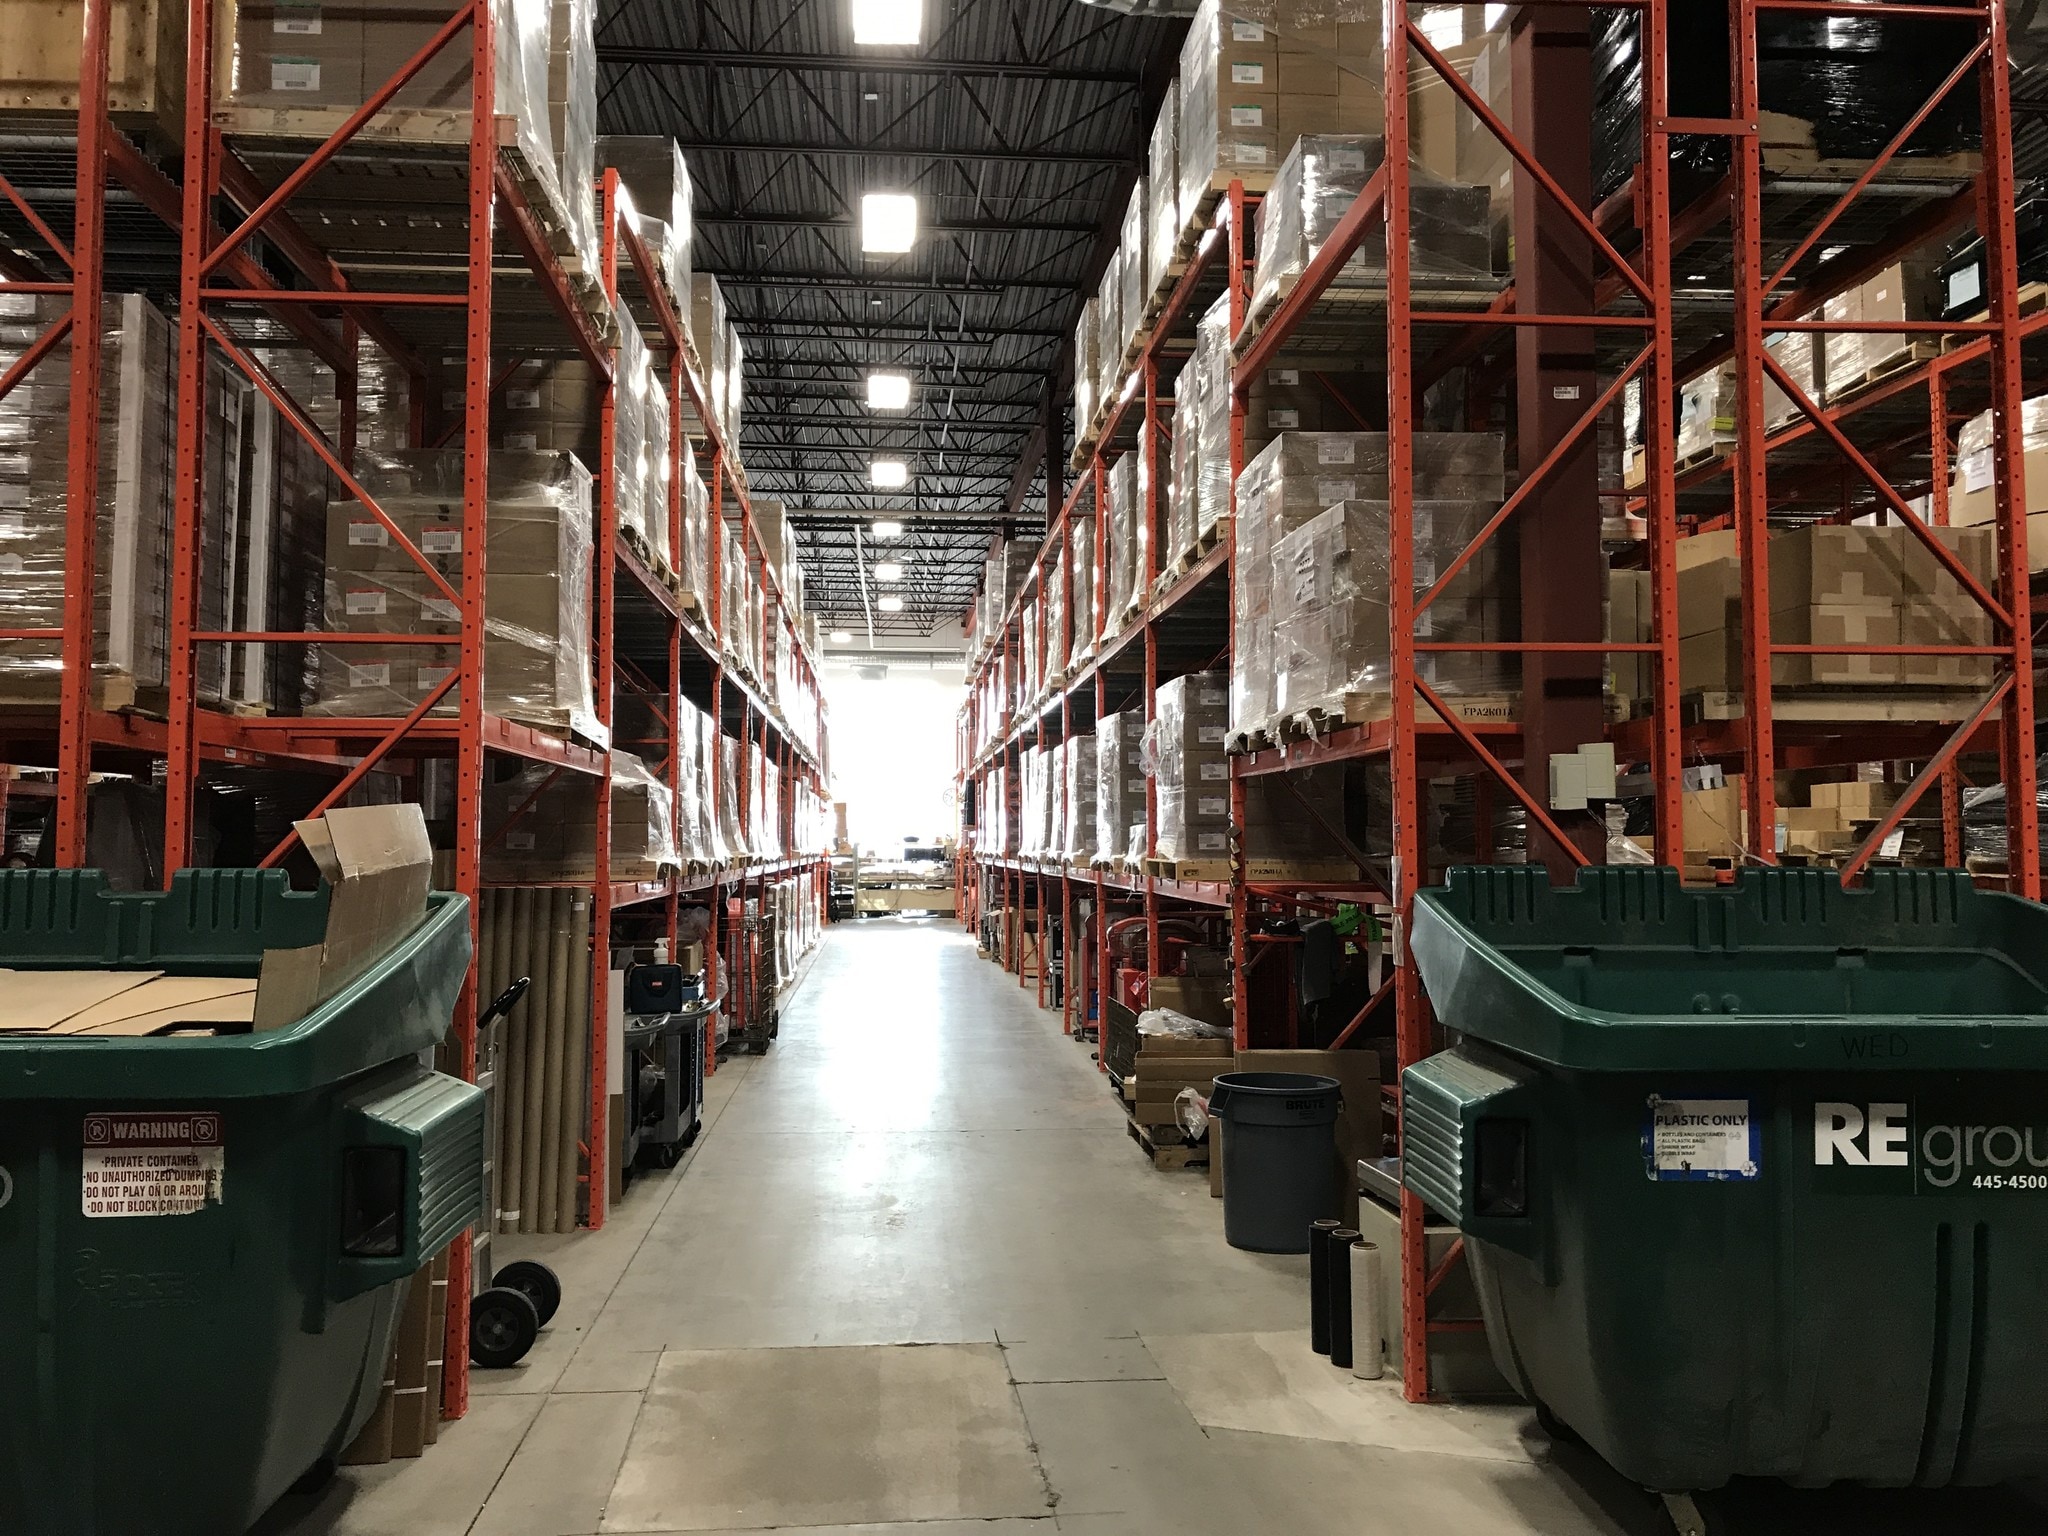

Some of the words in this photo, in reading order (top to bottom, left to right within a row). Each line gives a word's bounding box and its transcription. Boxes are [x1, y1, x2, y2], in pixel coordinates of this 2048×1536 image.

[1841, 1033, 1909, 1059] WED
[1286, 1099, 1326, 1110] BRUTE
[1655, 1115, 1710, 1126] PLASTIC
[1712, 1114, 1748, 1126] ONLY
[112, 1122, 190, 1139] WARNING
[1815, 1103, 1908, 1166] RE
[104, 1156, 143, 1168] PRIVATE
[147, 1155, 199, 1167] CONTAINER
[86, 1172, 99, 1183] NO
[102, 1170, 172, 1183] UNAUTHORIZED
[175, 1170, 217, 1182] DUMPING
[86, 1186, 99, 1198] DO
[102, 1186, 120, 1198] NOT
[123, 1186, 146, 1198] PLAY
[148, 1185, 161, 1197] ON
[164, 1185, 177, 1197] OR
[90, 1201, 103, 1213] DO
[106, 1201, 125, 1213] NOT
[128, 1200, 157, 1212] BLOCK
